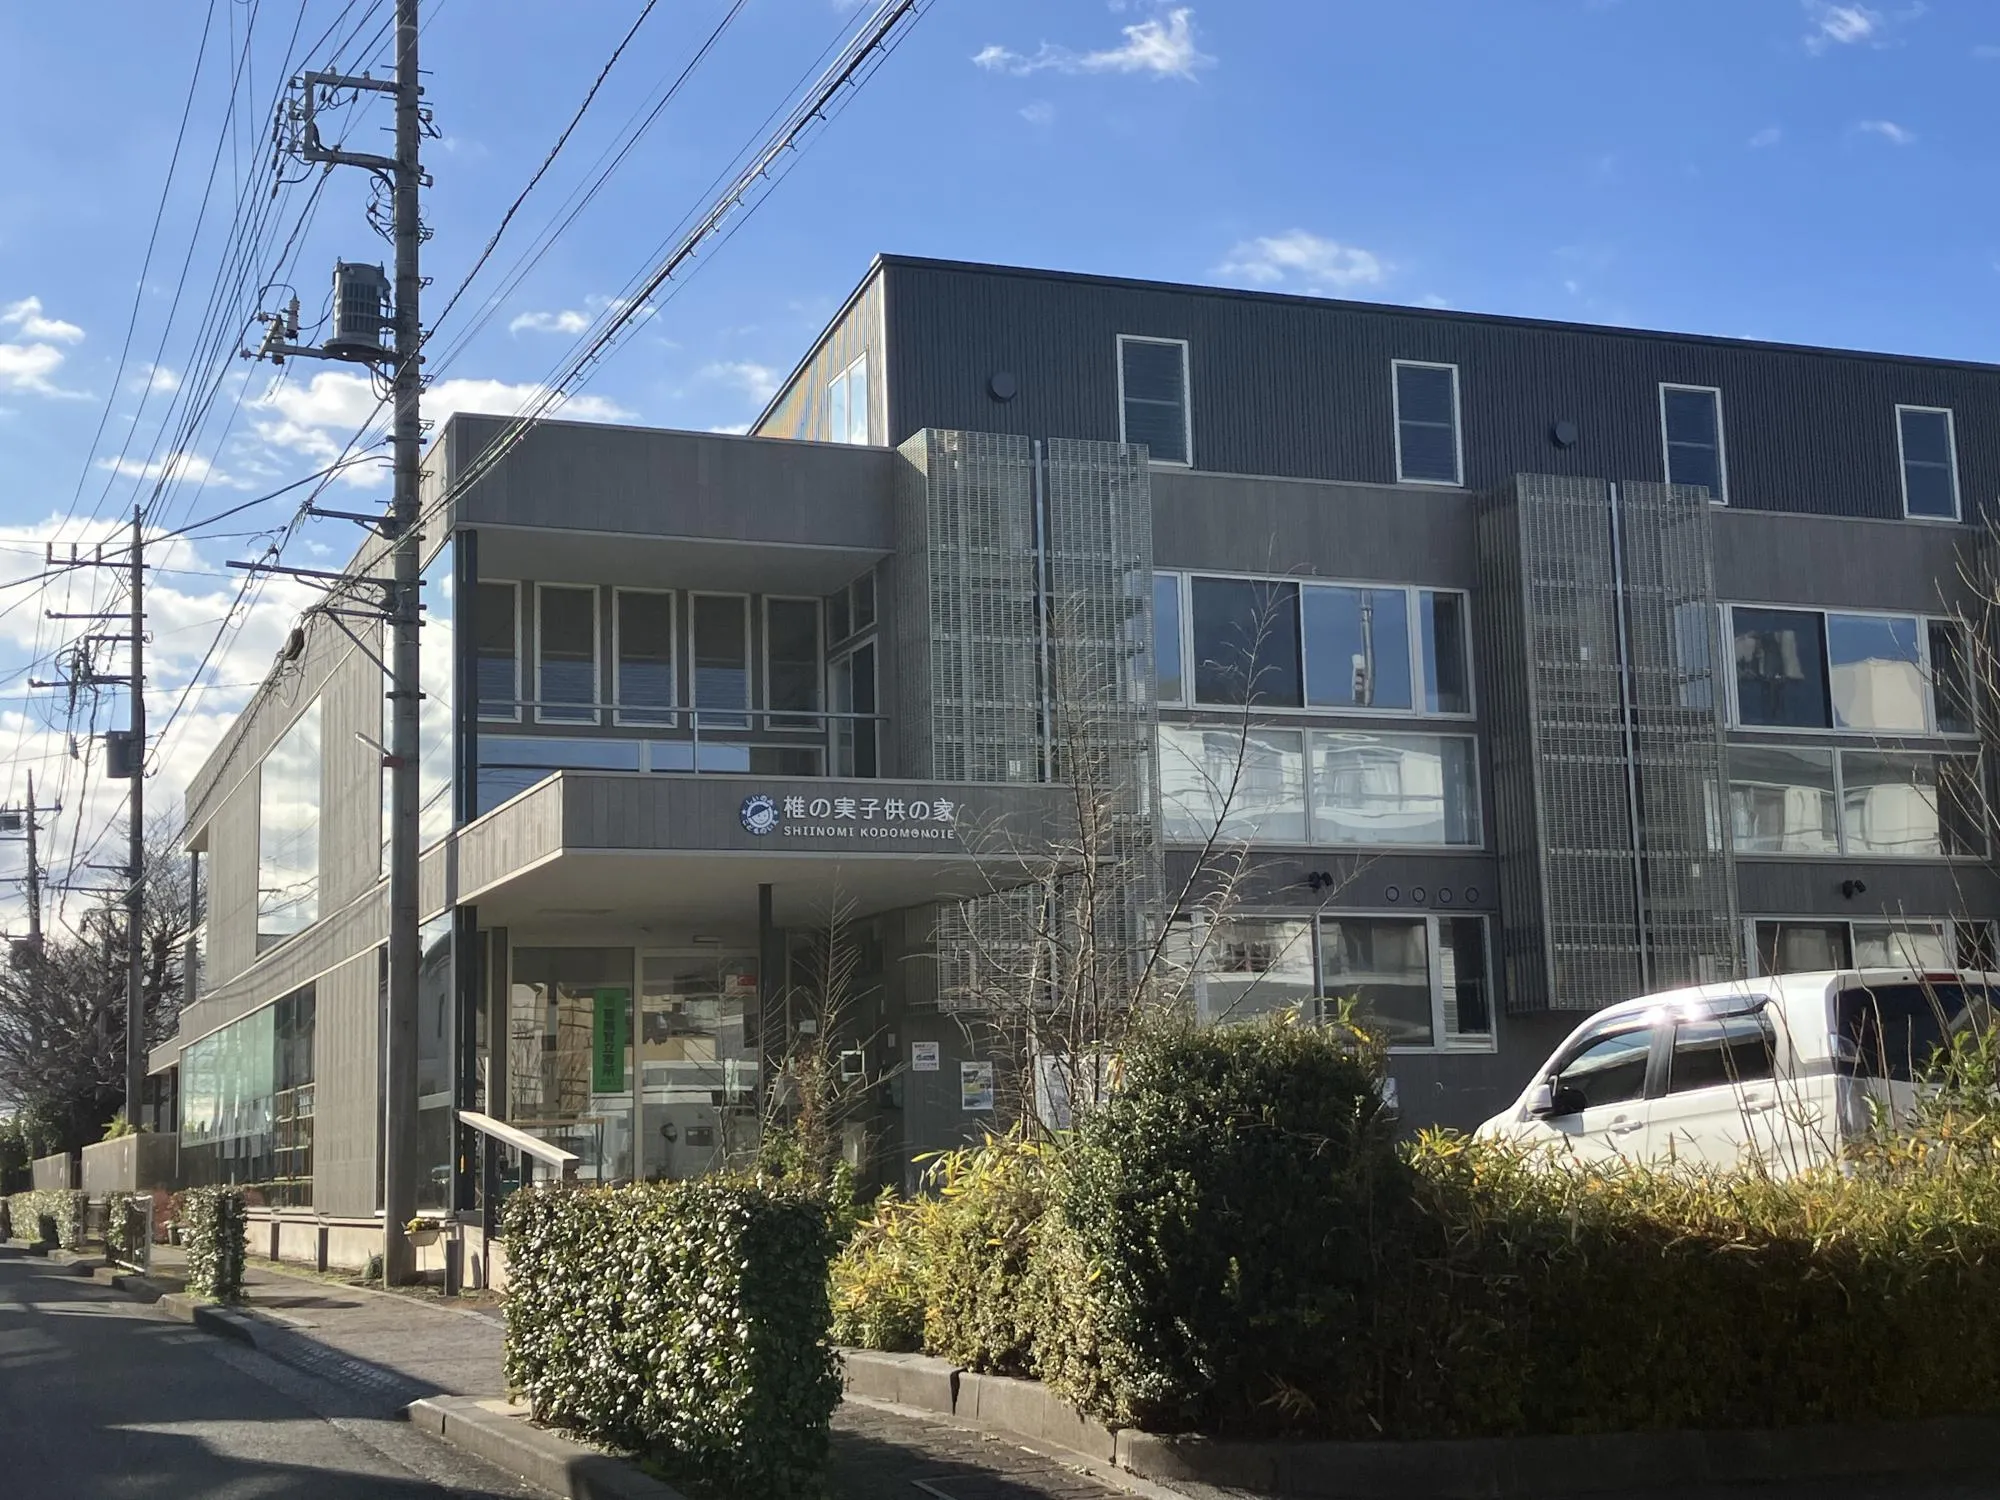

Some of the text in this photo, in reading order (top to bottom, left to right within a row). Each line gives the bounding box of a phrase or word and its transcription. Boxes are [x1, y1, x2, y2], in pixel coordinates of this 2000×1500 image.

[783, 795, 955, 822] 椎の実子供の家
[783, 825, 955, 840] SHIINOMI KODOMONOIE
